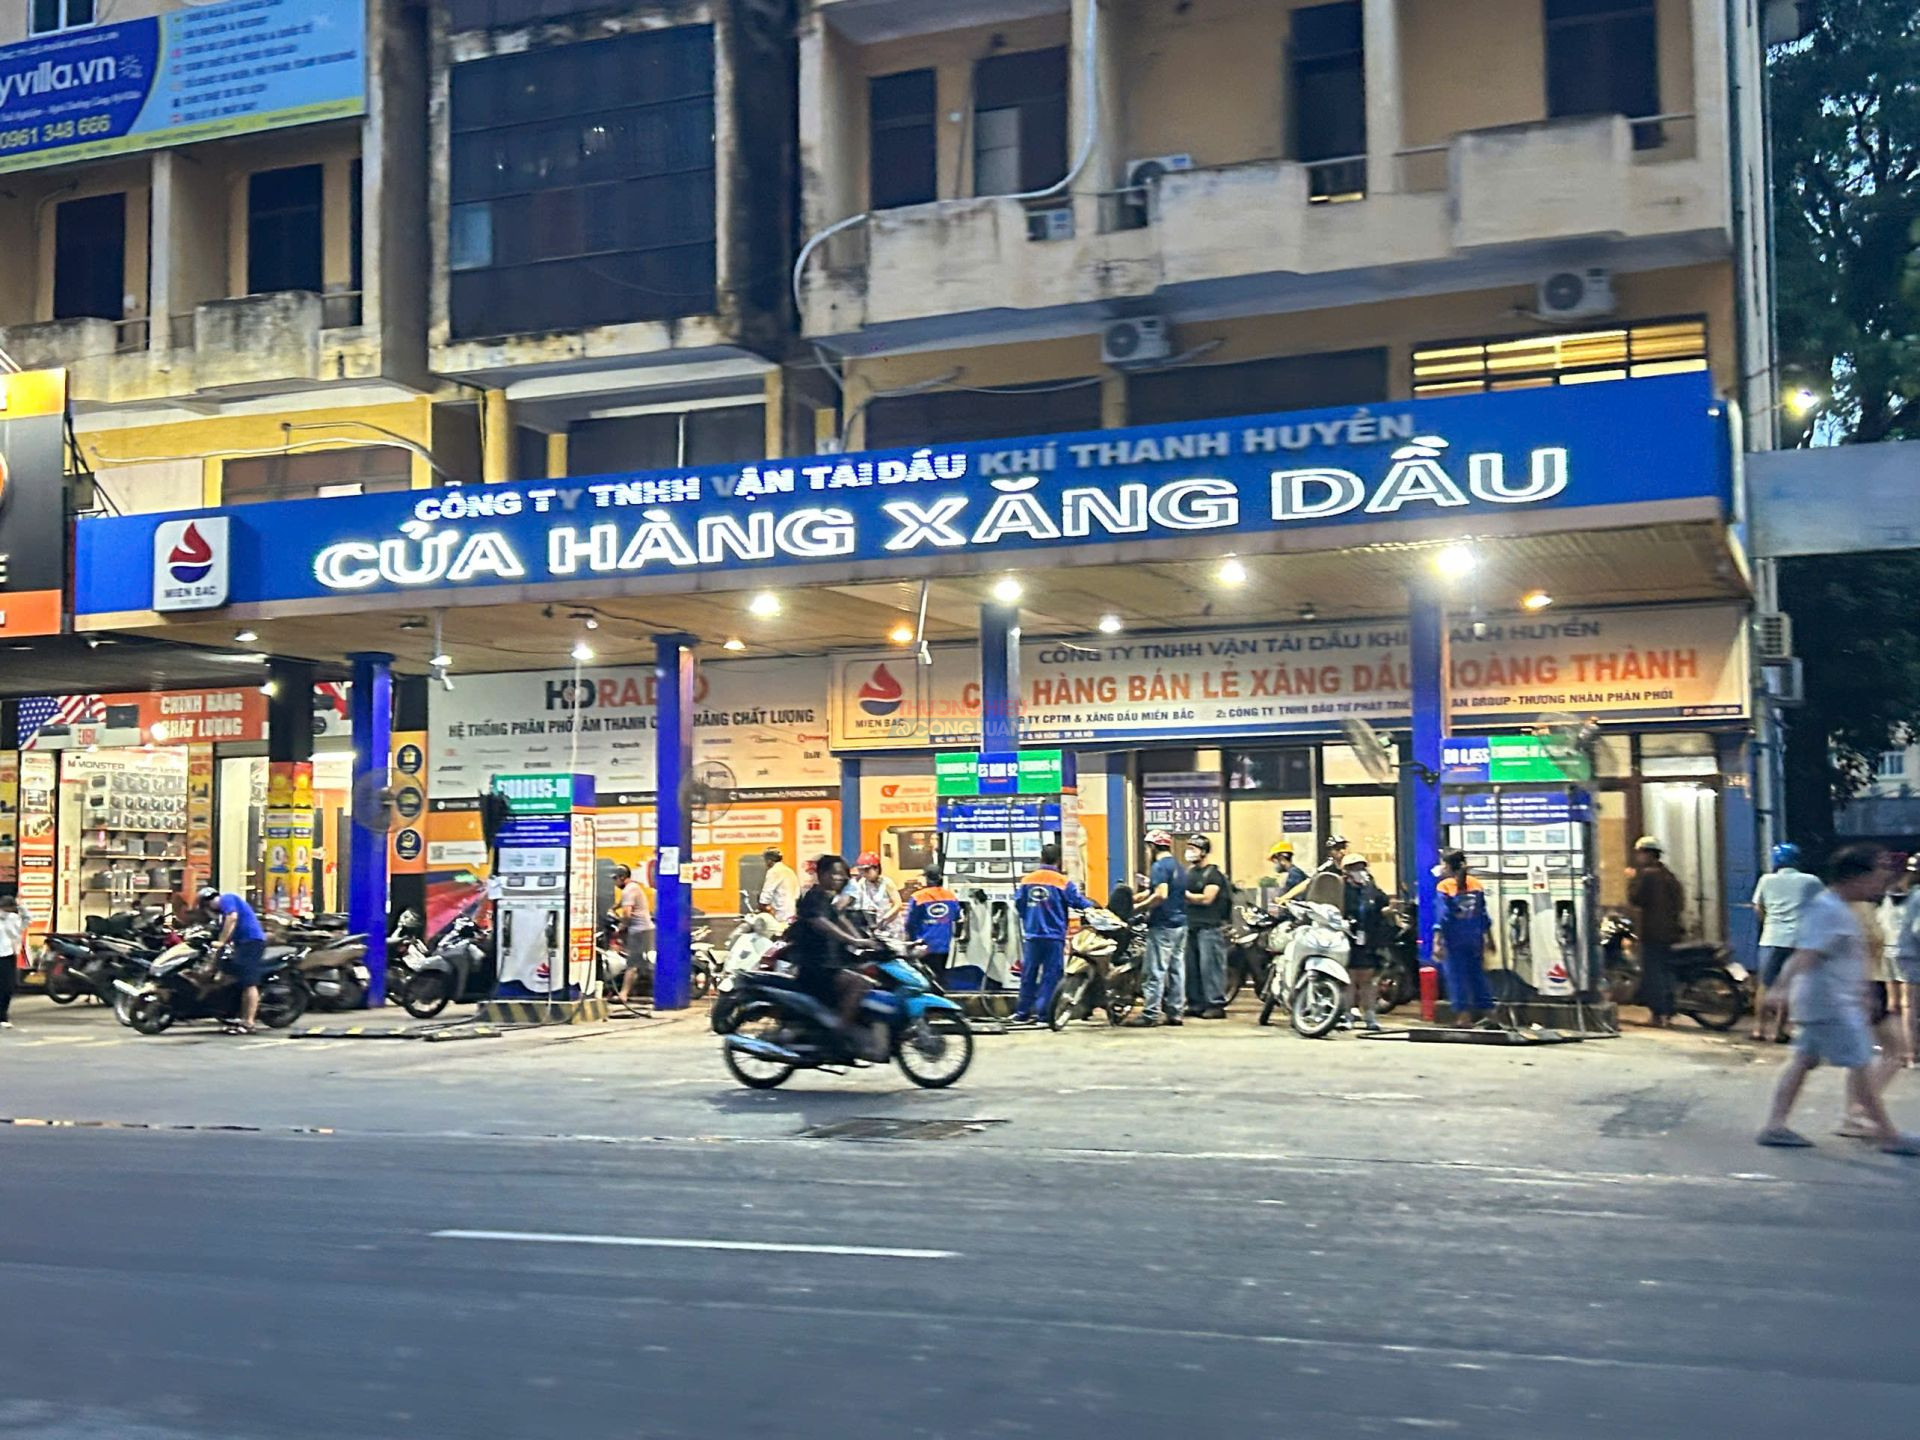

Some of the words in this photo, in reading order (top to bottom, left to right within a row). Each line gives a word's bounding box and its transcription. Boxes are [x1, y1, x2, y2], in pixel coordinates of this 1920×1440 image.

[414, 490, 522, 520] CÔNG
[528, 488, 583, 512] TY
[588, 476, 701, 507] TNHH
[711, 466, 795, 501] VẬN
[1068, 431, 1230, 468] THANH
[313, 519, 526, 589] CỬA
[548, 508, 856, 575] HÀNG
[880, 476, 1240, 550] XĂNG
[1270, 435, 1569, 520] DẦU
[1110, 646, 1135, 661] TY
[1144, 643, 1202, 658] TNHH
[1570, 645, 1697, 683] THÀNH
[1032, 672, 1117, 706] HÀNG
[1128, 667, 1191, 702] BÁN
[1202, 660, 1239, 698] LẺ
[1250, 661, 1342, 696] XĂNG
[604, 716, 646, 732] THANH
